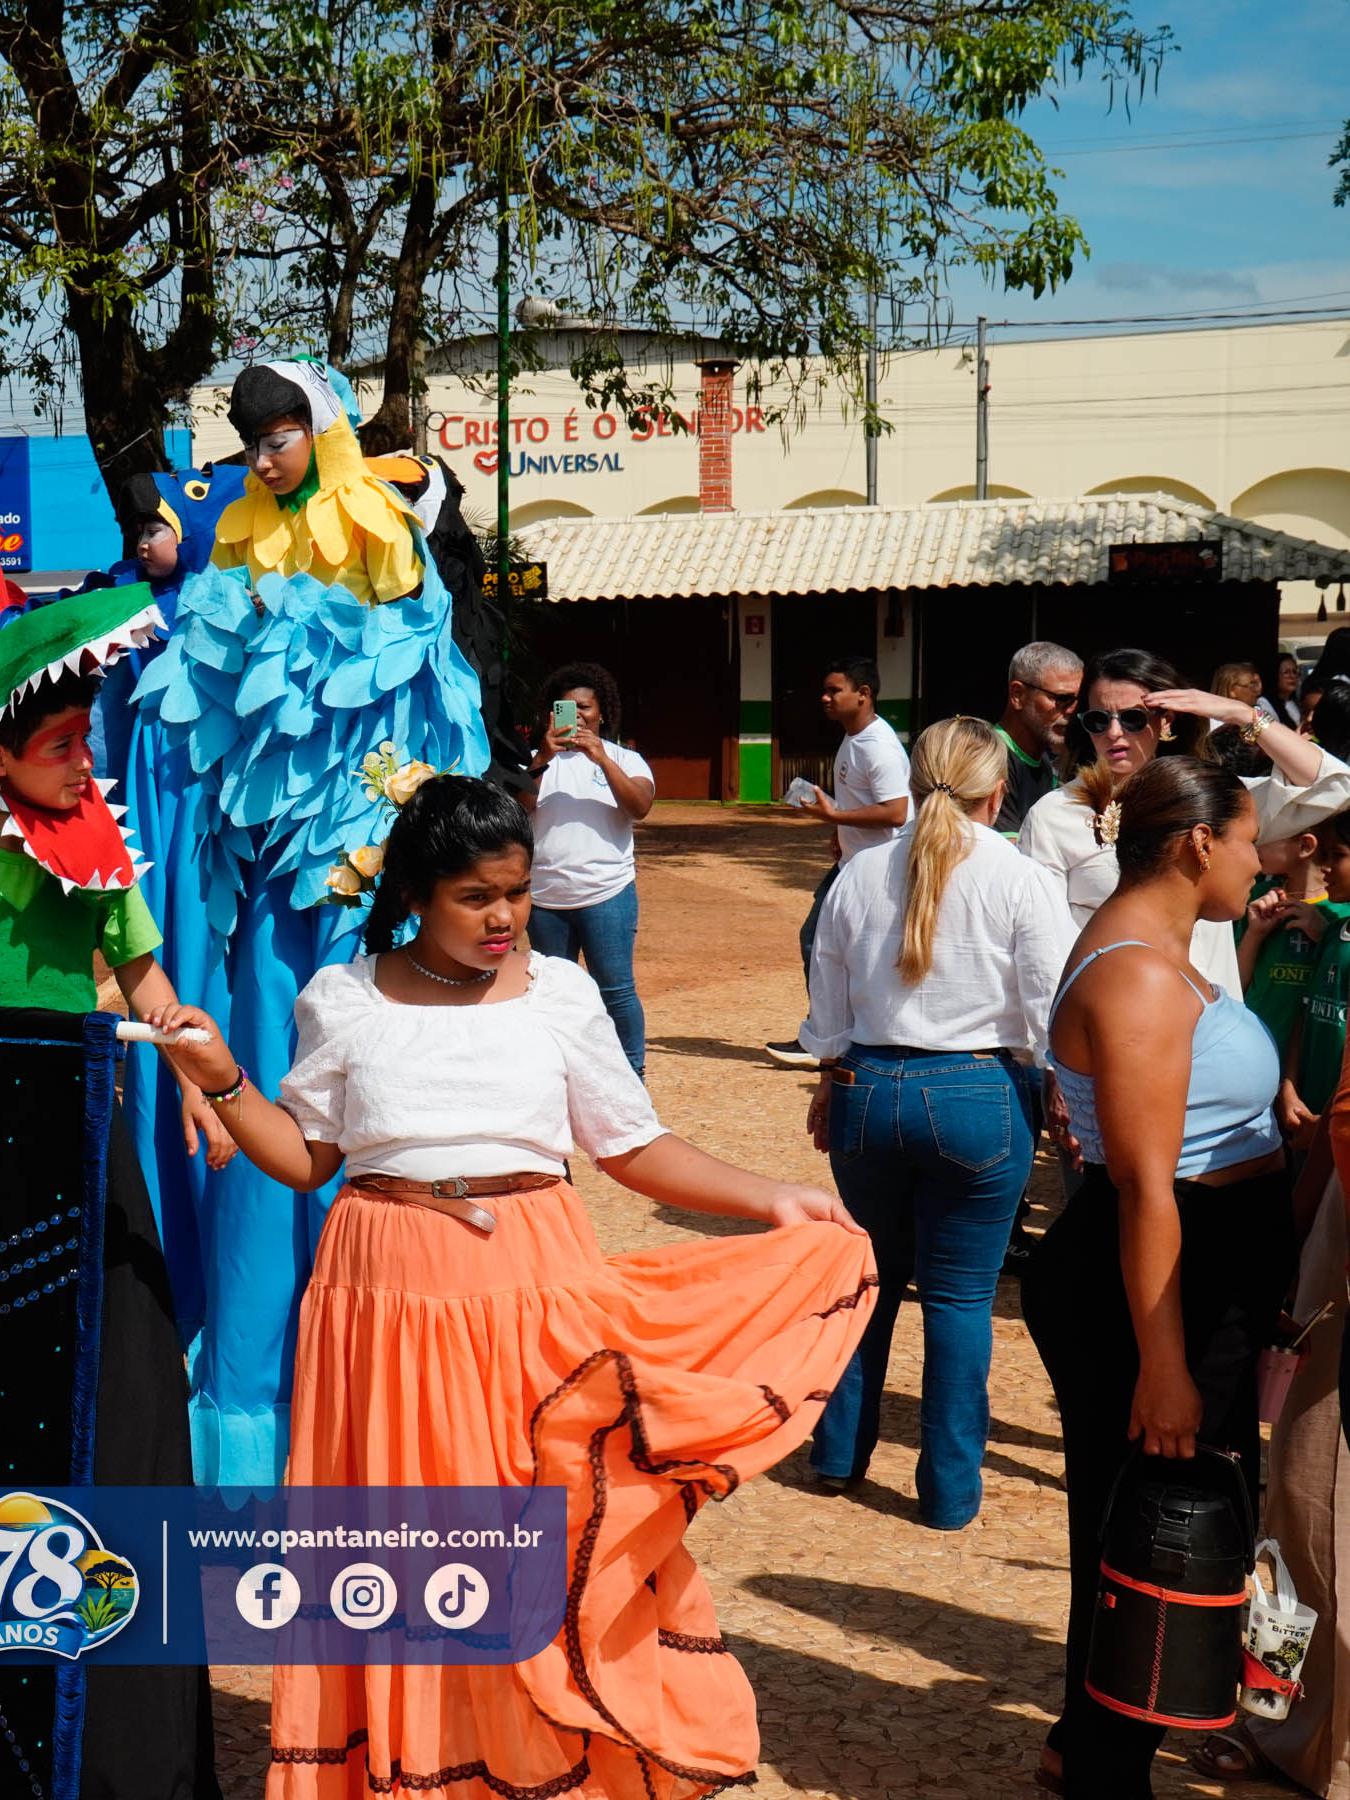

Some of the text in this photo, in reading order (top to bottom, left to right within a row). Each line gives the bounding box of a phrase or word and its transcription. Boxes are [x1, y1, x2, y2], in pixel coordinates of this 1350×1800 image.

[439, 405, 766, 450] CRISTO É O SENOR
[507, 450, 624, 477] UNIVERSAL
